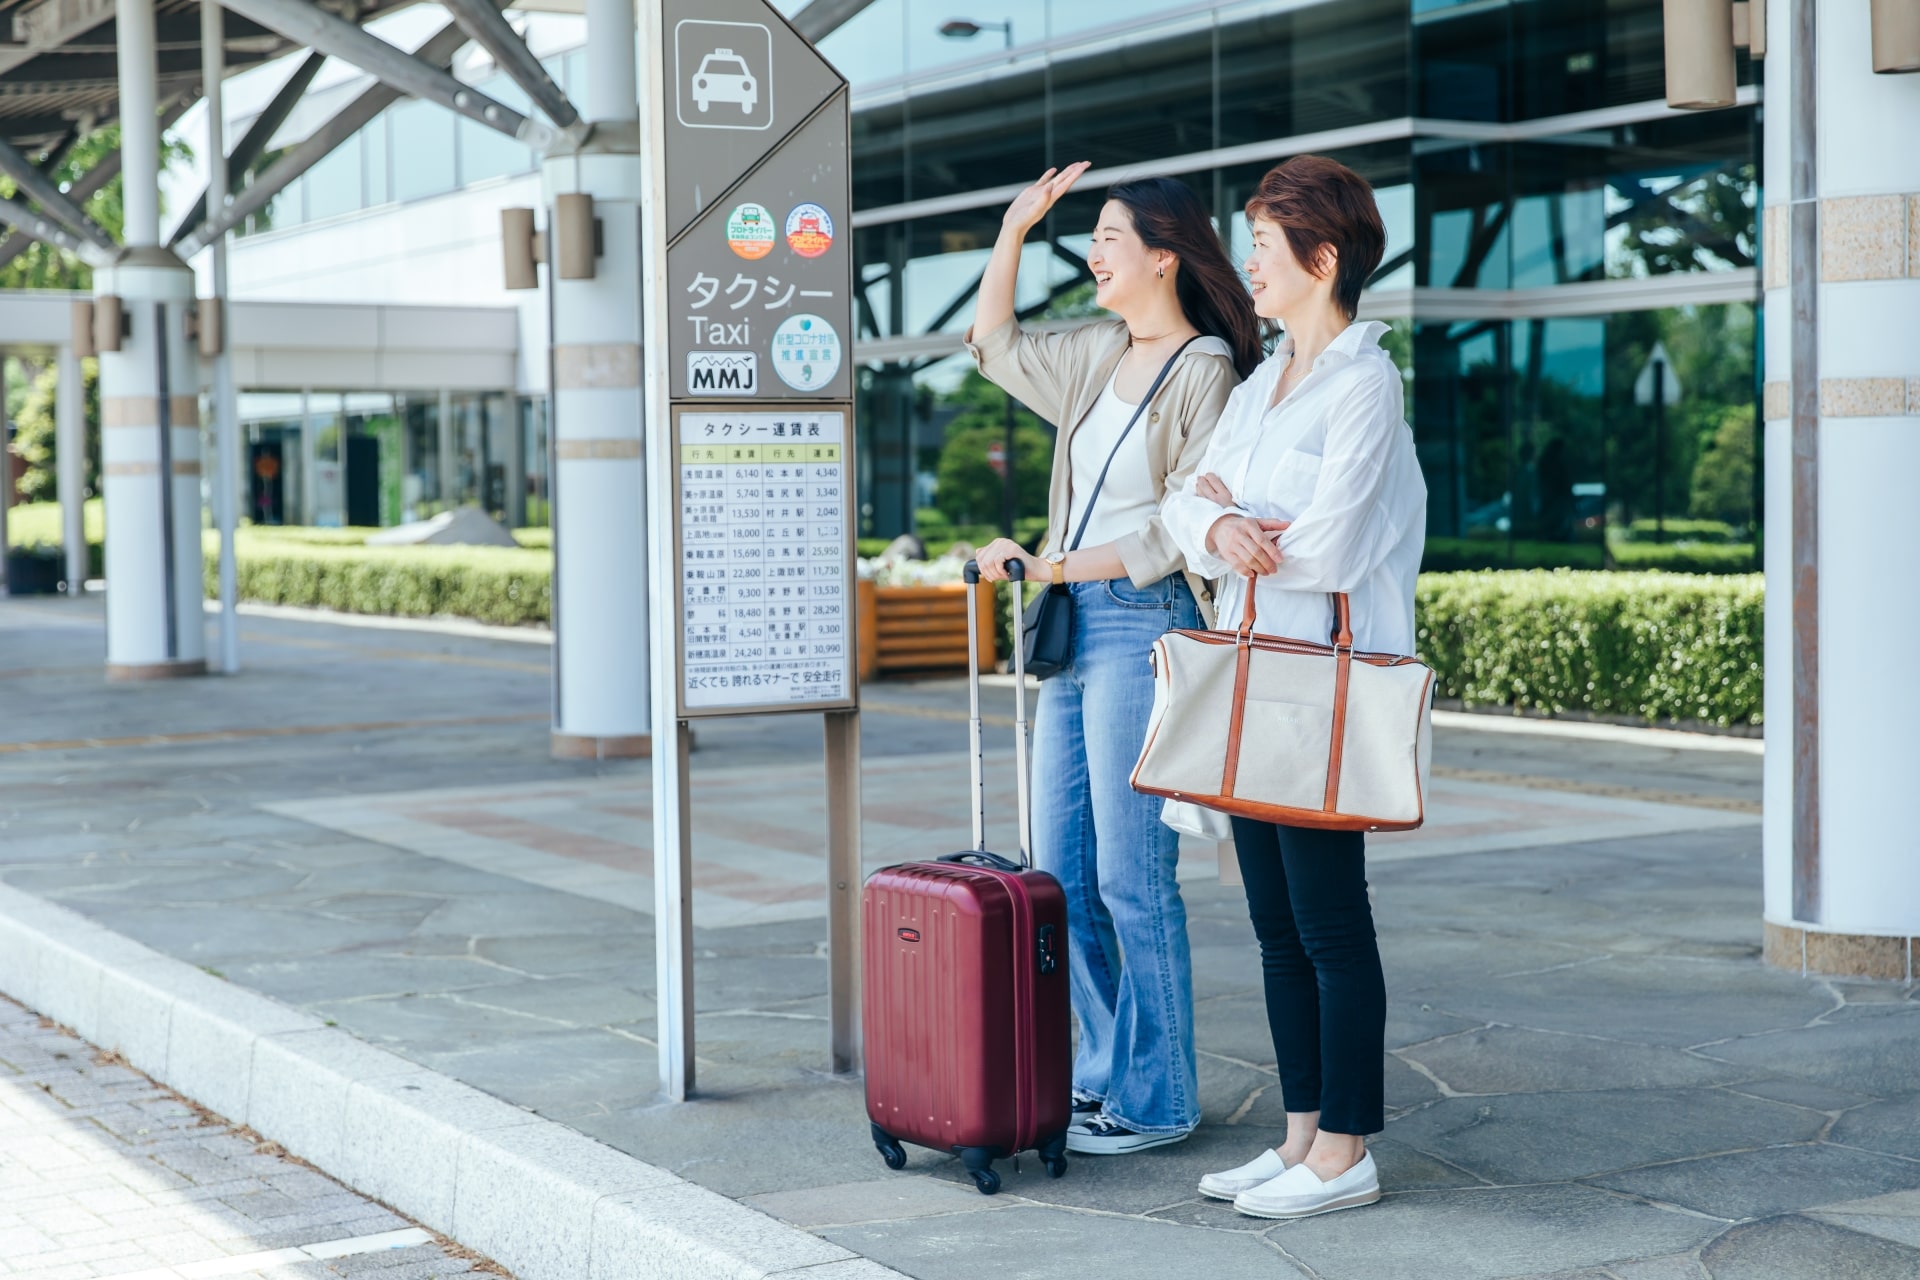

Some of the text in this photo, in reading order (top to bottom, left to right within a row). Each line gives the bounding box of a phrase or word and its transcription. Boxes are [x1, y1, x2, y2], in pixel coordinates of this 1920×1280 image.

[687, 272, 833, 309] タクシー
[687, 315, 748, 345] Taxi
[692, 368, 753, 389] MMJ
[705, 422, 819, 436] タクシー運賃表
[692, 449, 834, 459] 行先 運賃 行先 運賃
[684, 468, 837, 479] 浅間温泉 6,140 松本駅 4,340
[737, 489, 759, 498] 5,740
[766, 488, 803, 498] 塩尻駅
[817, 488, 838, 497] 3,340
[732, 509, 760, 519] 13,530
[767, 508, 804, 517] 村井駅
[817, 508, 838, 516] 2,040
[733, 529, 760, 538] 18,000
[767, 528, 804, 537] 広丘駅
[733, 549, 760, 558] 15,690
[768, 548, 804, 557] 白馬駅
[812, 546, 839, 556] 25,950
[733, 568, 760, 578] 22,800
[768, 567, 804, 576] 上諏訪駅
[813, 566, 839, 576] 11,730
[738, 589, 761, 598] 9,300
[769, 587, 805, 596] 茅野駅
[813, 586, 840, 595] 13,530
[734, 608, 761, 618] 18,480
[769, 606, 805, 616] 長野駅
[813, 605, 839, 615] 28,290
[687, 622, 840, 637] 松本城 4,540 穂高駅 9,300
[734, 648, 762, 657] 24,240
[769, 645, 806, 655] 高山駅
[814, 644, 840, 653] 30,990
[688, 670, 841, 689] 近くても 誇れるマナーで 安全走行
